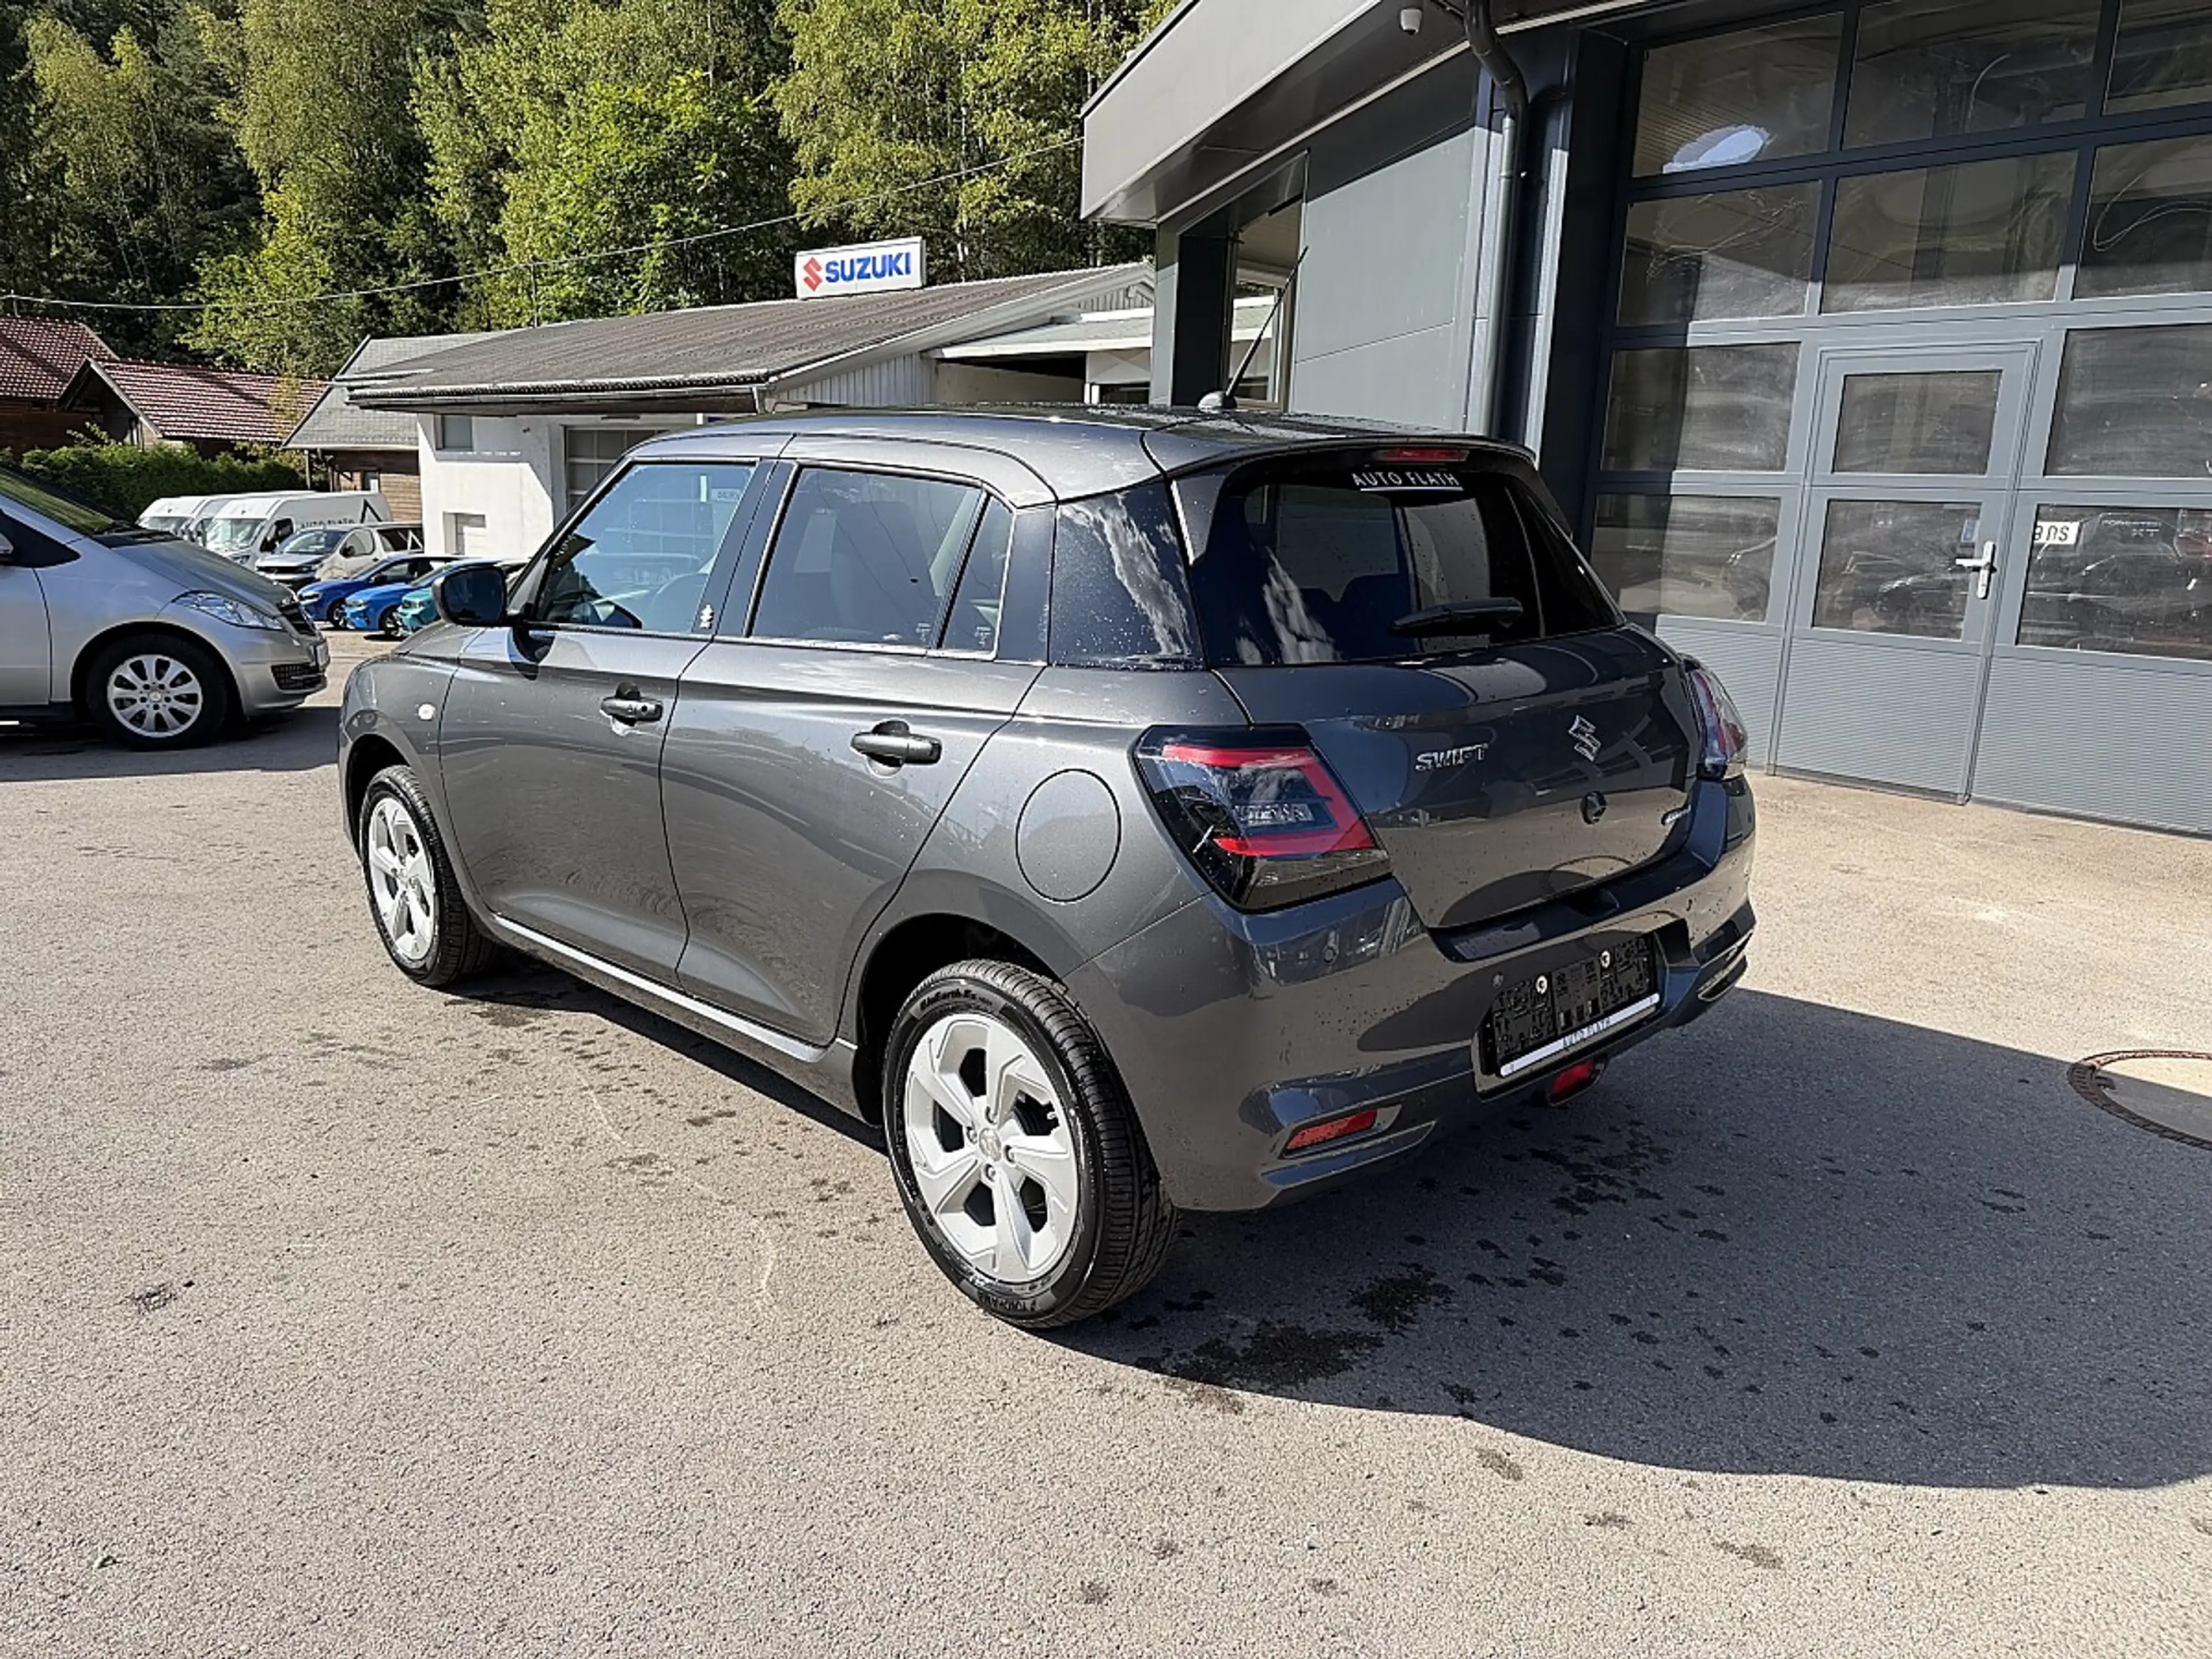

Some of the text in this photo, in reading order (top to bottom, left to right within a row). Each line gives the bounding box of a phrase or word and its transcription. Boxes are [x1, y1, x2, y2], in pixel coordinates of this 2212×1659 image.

[825, 252, 911, 283] SUZUKI
[1352, 471, 1460, 486] AUTO FLATH
[1415, 743, 1488, 771] SWIFT
